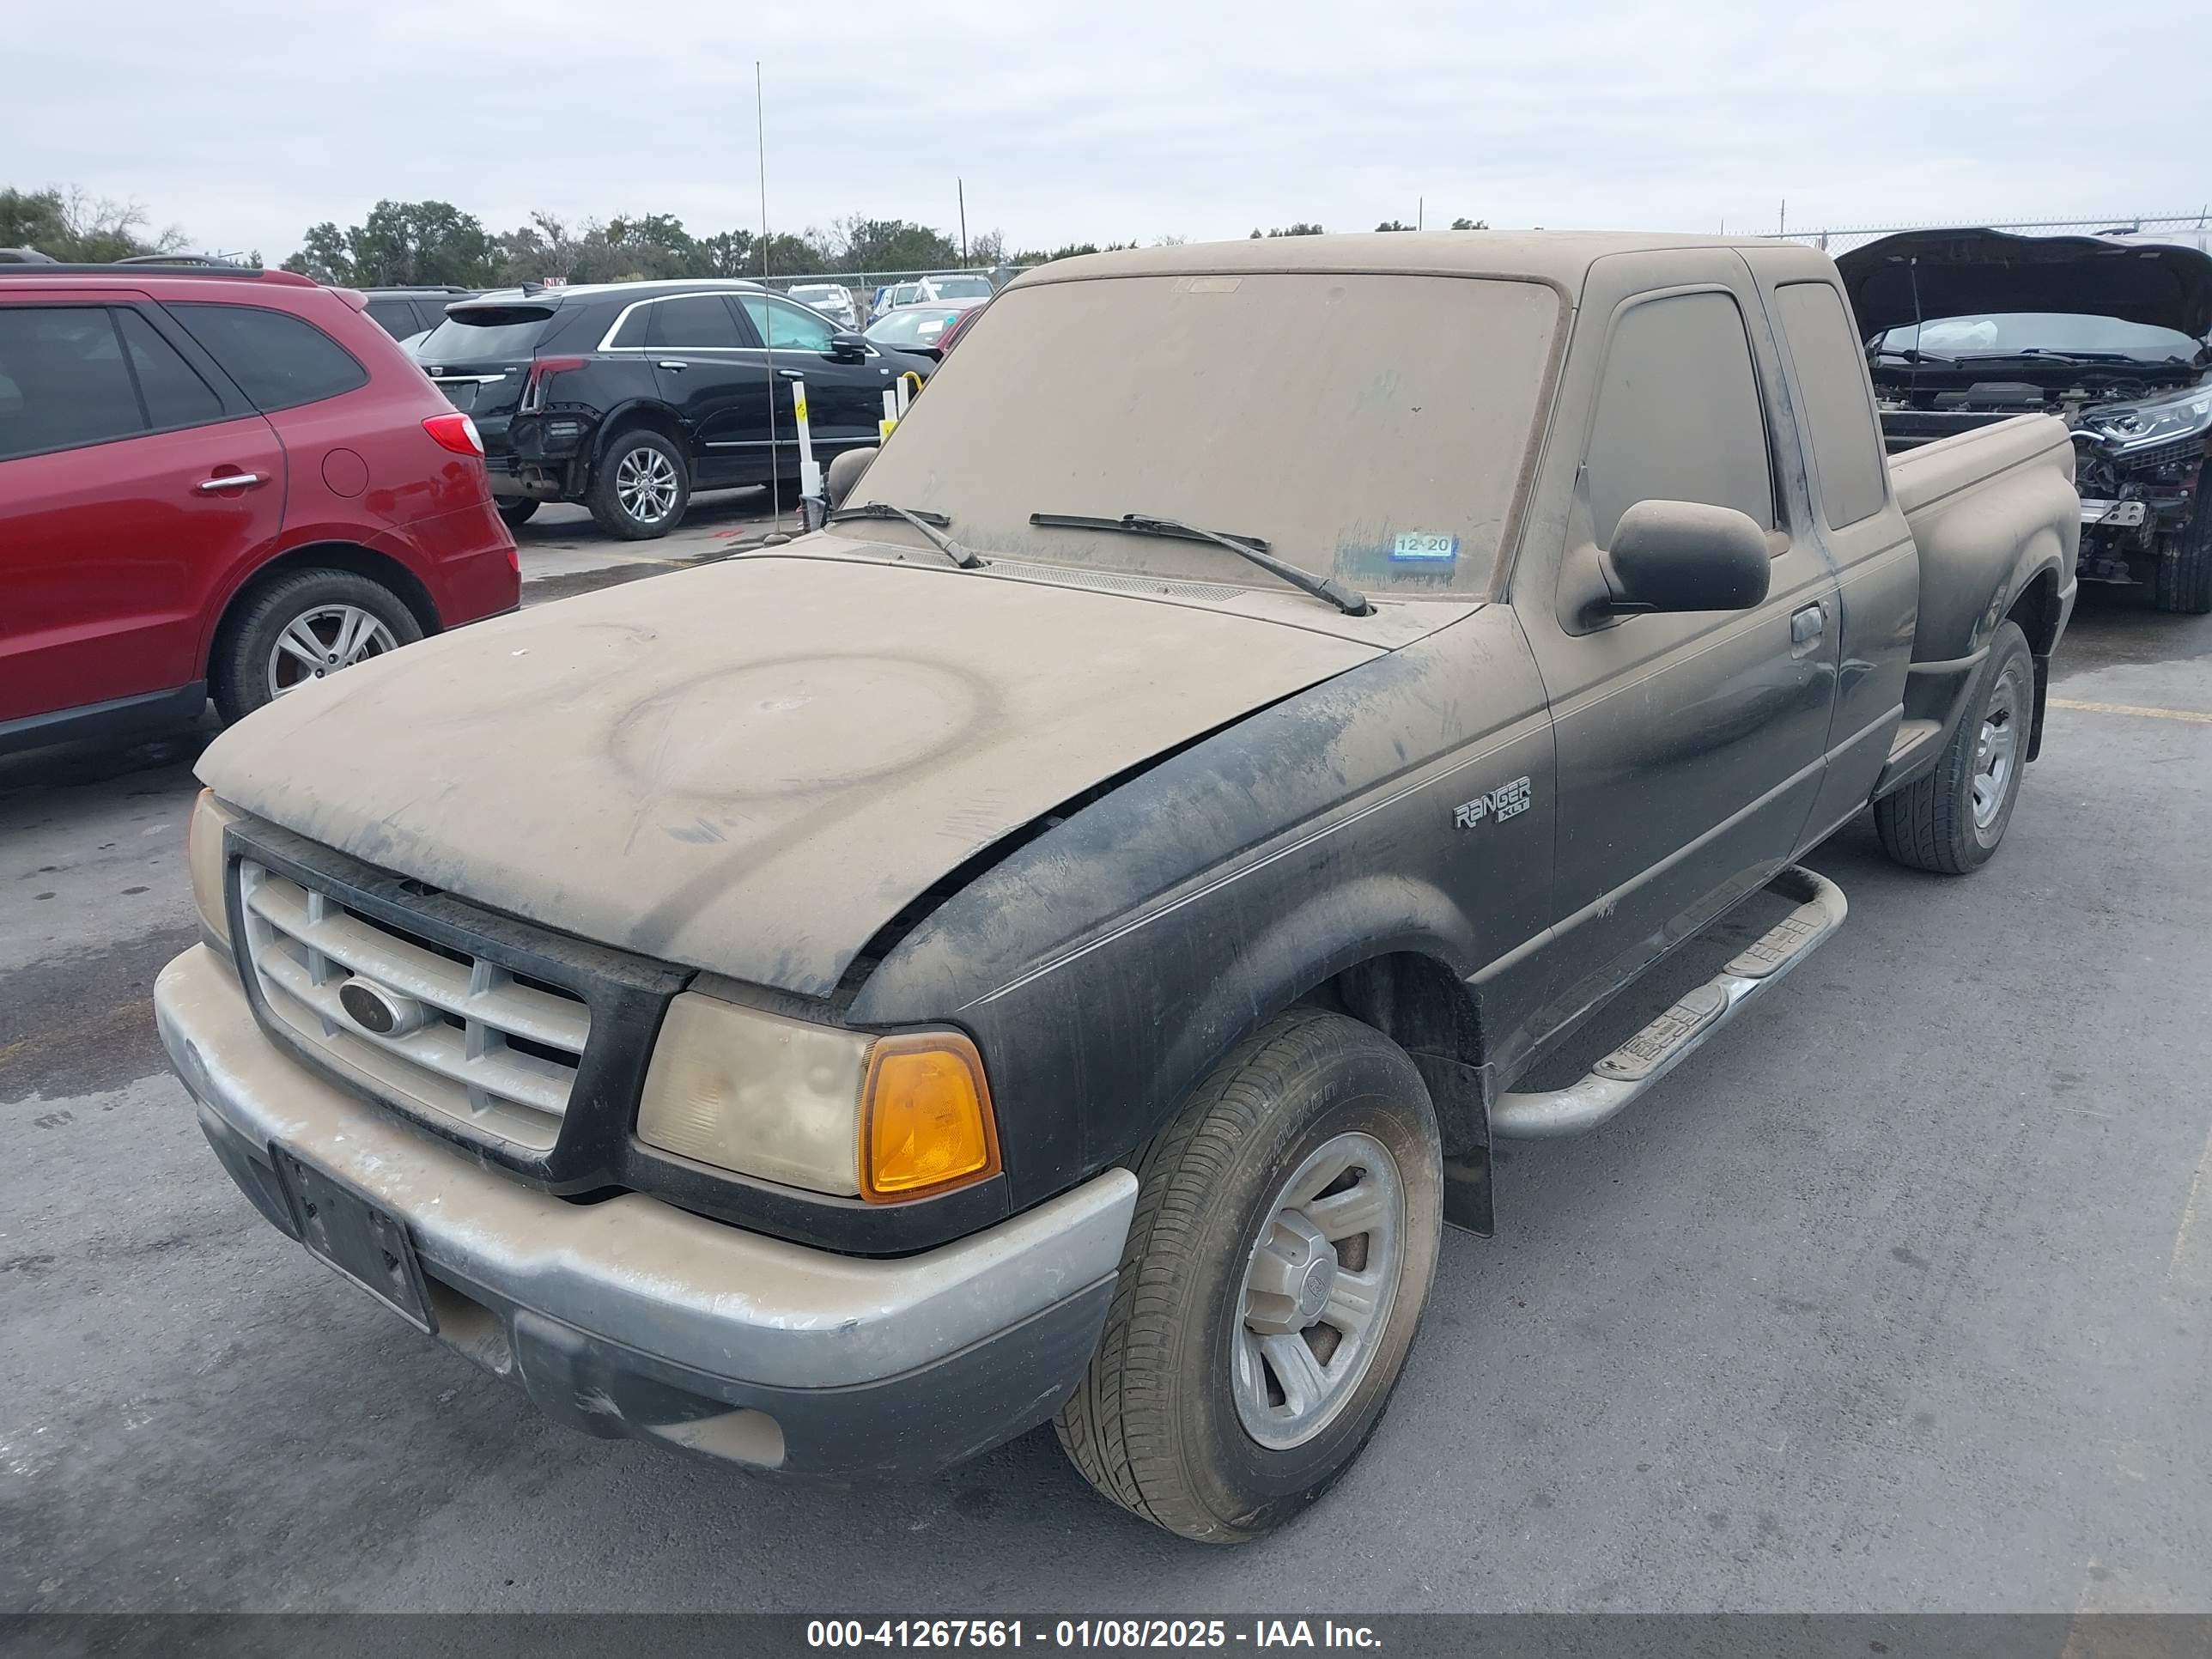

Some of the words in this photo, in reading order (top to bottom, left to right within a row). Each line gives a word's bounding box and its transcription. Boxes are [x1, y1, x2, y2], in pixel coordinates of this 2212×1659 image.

[1428, 538, 1449, 551] 20
[1453, 775, 1532, 829] RANGER
[1499, 798, 1529, 821] XLT
